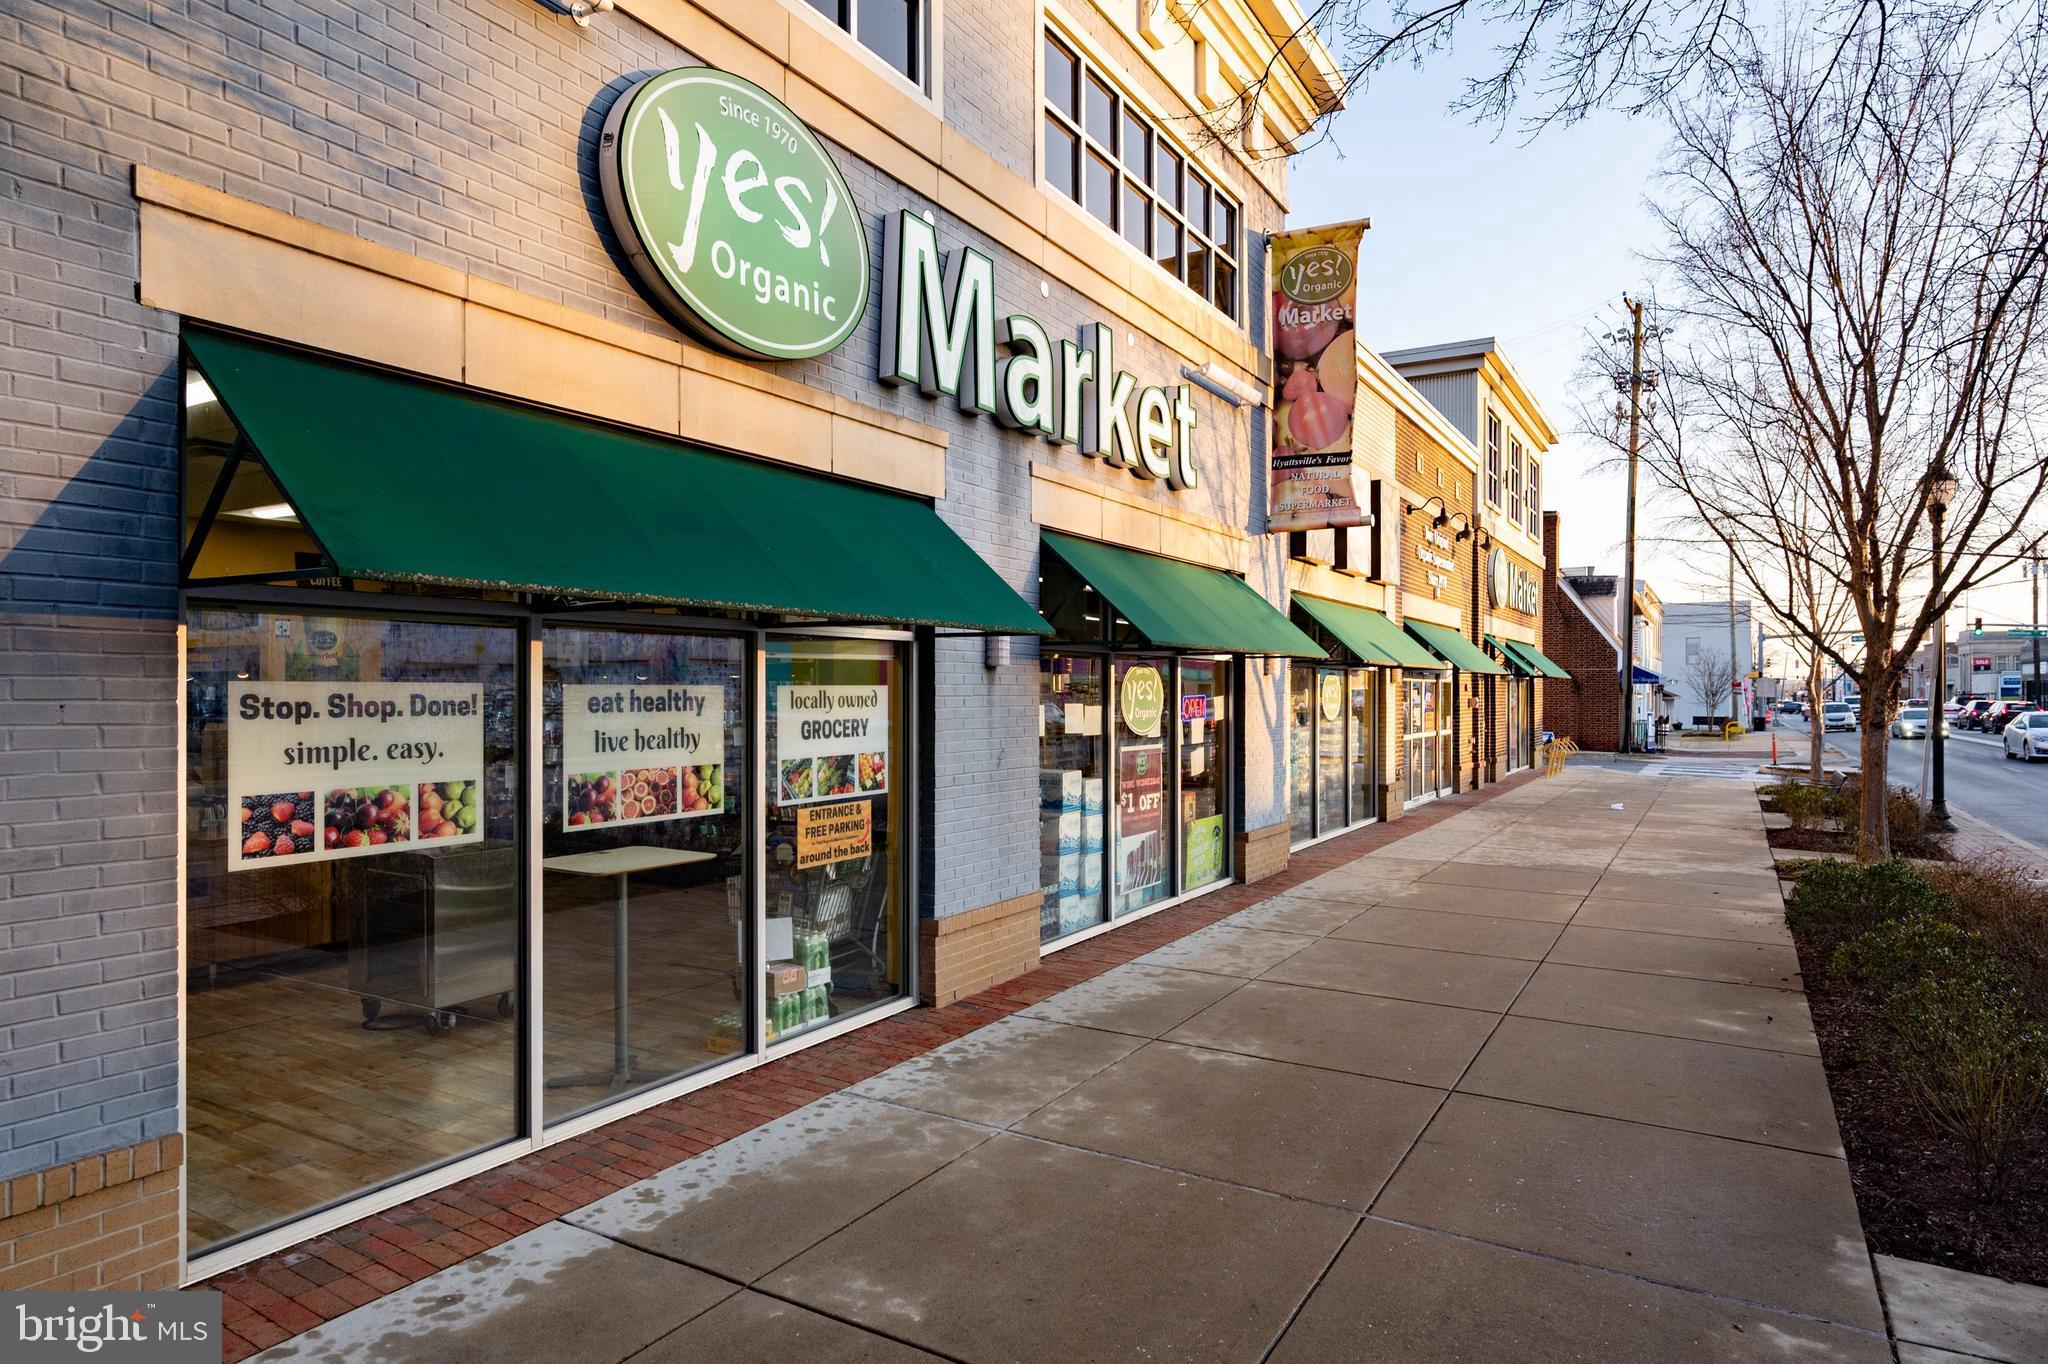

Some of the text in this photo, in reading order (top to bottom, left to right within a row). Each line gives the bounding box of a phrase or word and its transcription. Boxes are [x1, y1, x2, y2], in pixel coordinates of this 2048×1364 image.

[719, 95, 799, 154] Since 1970
[658, 106, 839, 273] yes!
[711, 240, 837, 322] Organic
[1302, 281, 1342, 293] Organic
[1279, 304, 1353, 325] Market
[894, 207, 1198, 490] Market
[1272, 456, 1322, 469] Hyattsville's
[1291, 471, 1341, 481] NATURAL
[1302, 485, 1331, 496] FOOD
[1279, 498, 1352, 512] SUPERMARKET
[239, 692, 478, 725] Stop. Shop. Done!
[587, 688, 706, 717] eat healthy
[790, 689, 878, 714] locally owned
[1183, 697, 1206, 719] OPEN
[1134, 706, 1158, 721] Organic
[801, 718, 869, 740] GROCERY
[594, 727, 701, 754] live healthy
[283, 737, 444, 770] simple. easy.
[809, 803, 862, 821] ENTRANCE &
[1121, 792, 1161, 814] $1 OFF
[805, 819, 865, 839] FREE PARKING
[800, 847, 832, 864] around
[834, 845, 849, 858] the
[850, 840, 870, 855] back
